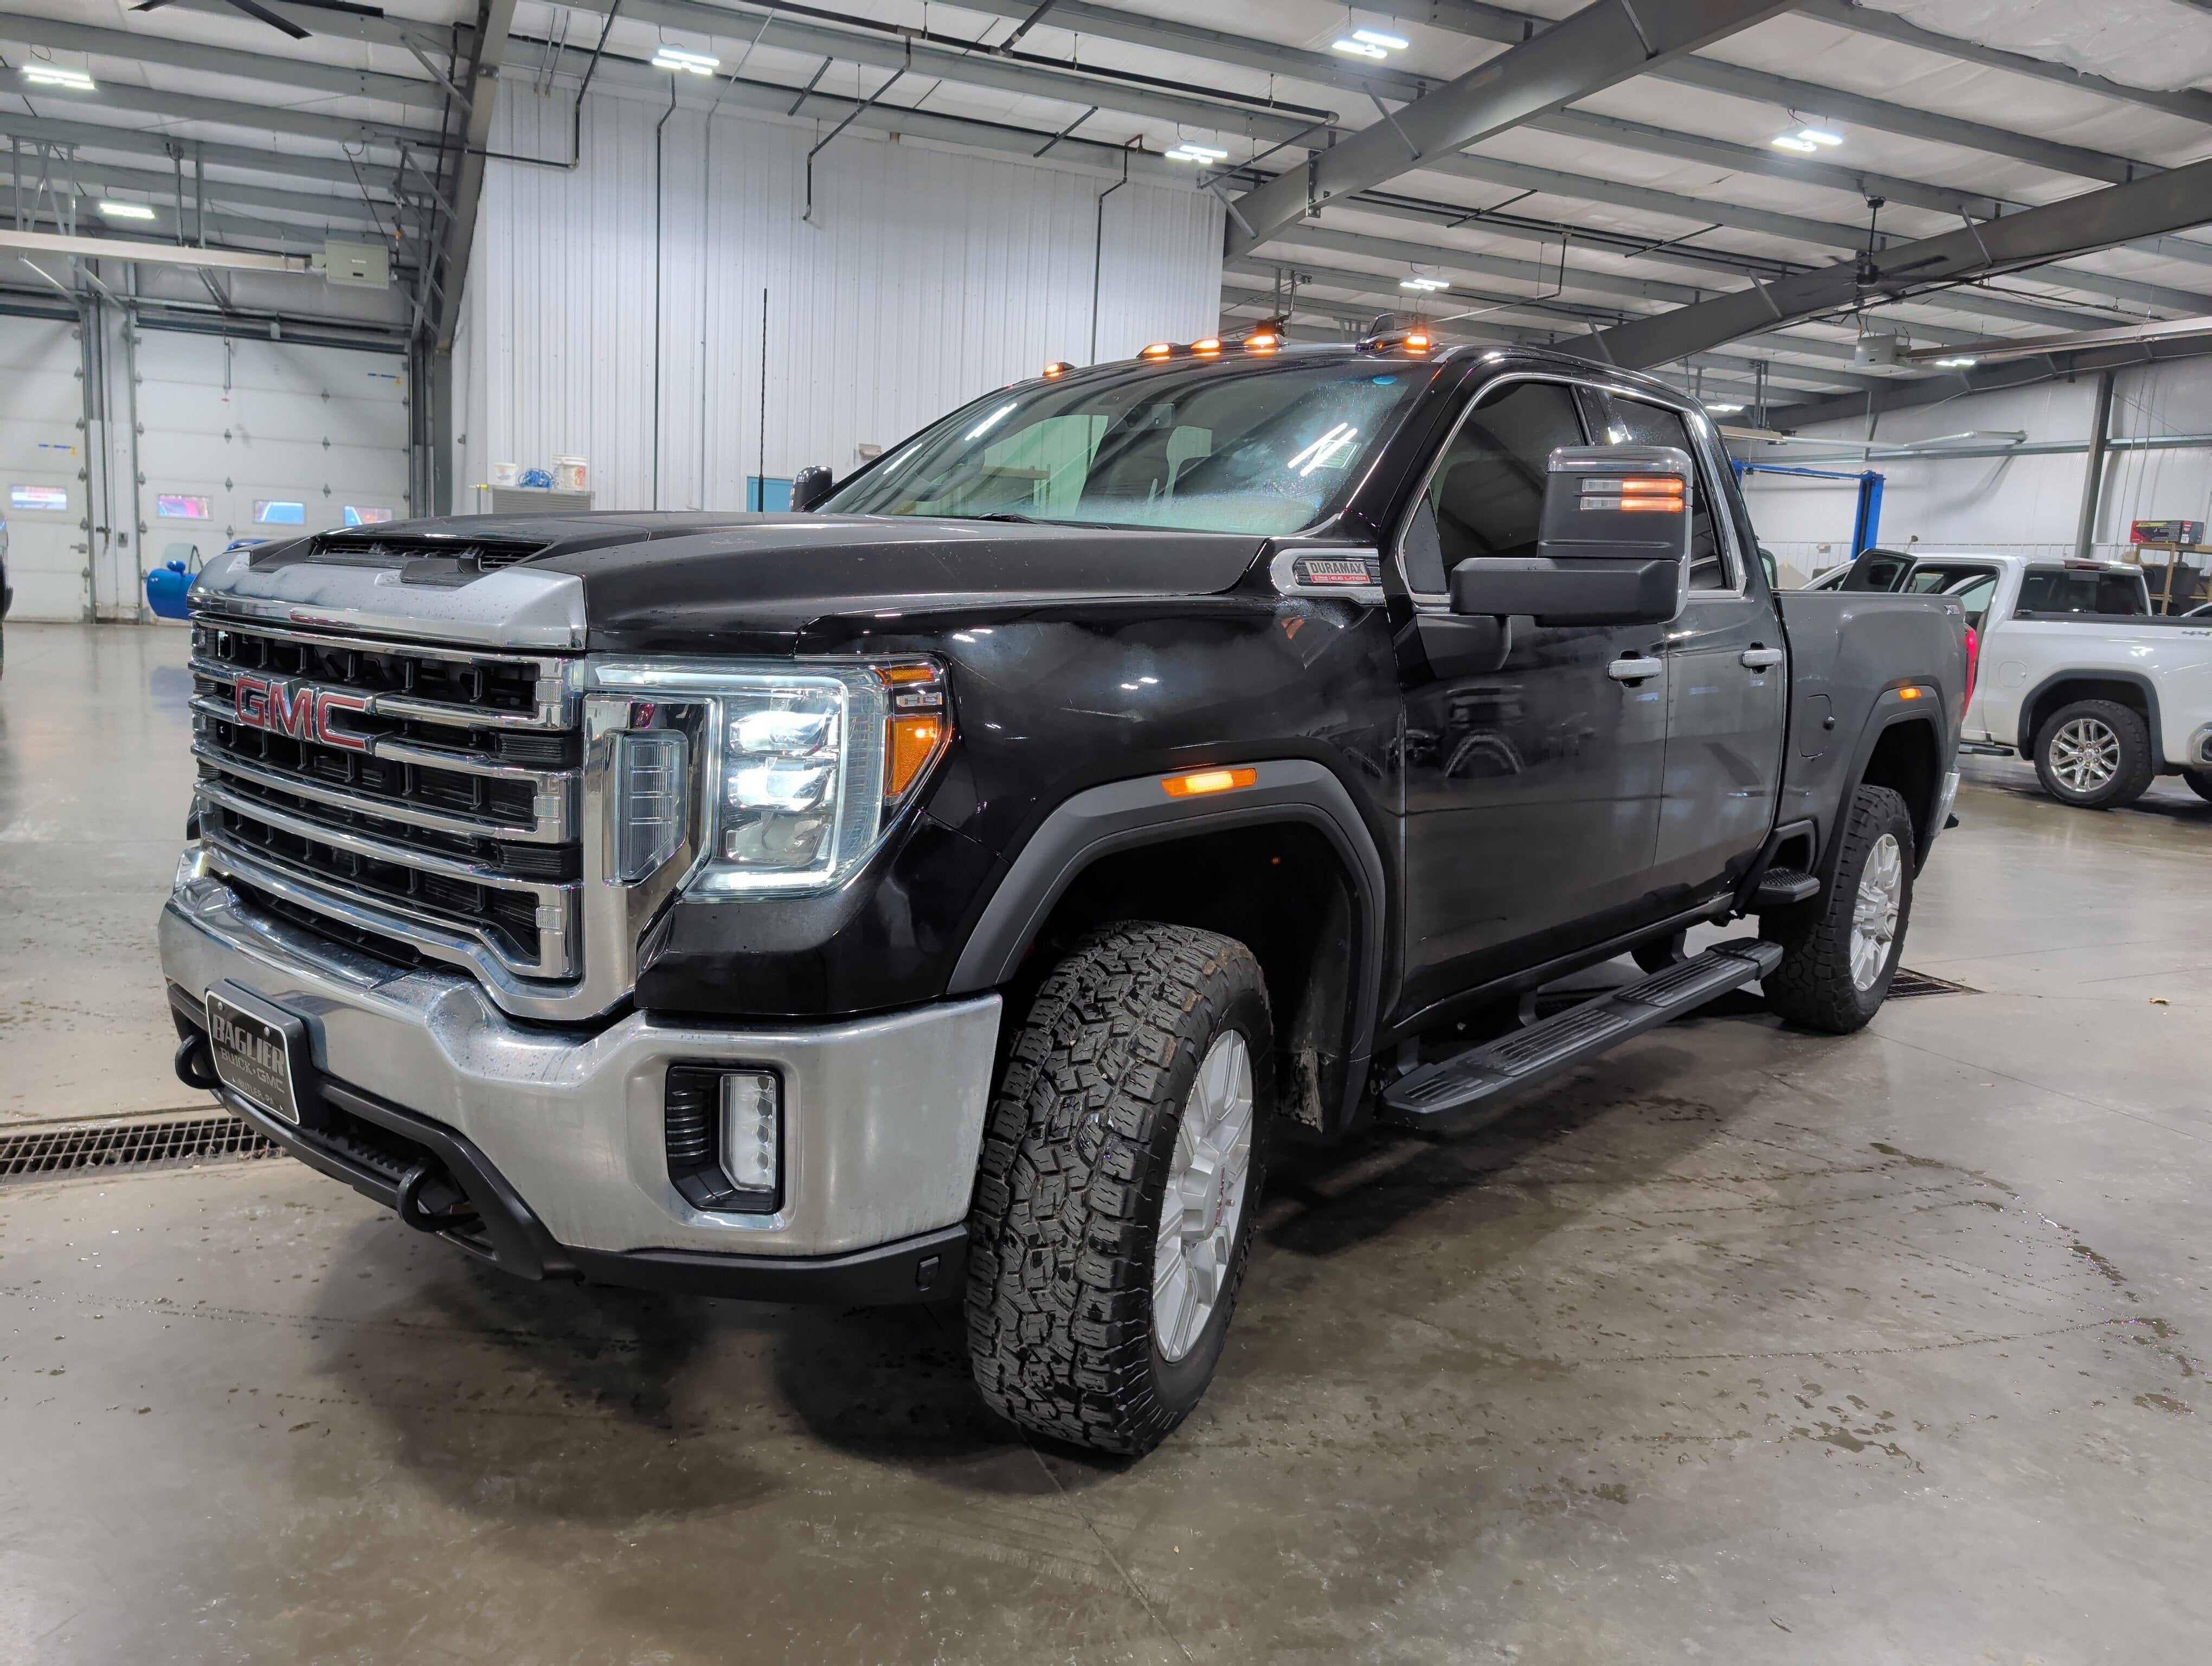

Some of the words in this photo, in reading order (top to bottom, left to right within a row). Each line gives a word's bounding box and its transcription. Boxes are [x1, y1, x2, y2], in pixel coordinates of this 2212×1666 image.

[1310, 562, 1364, 574] DURAMAX
[236, 677, 370, 752] GMC
[213, 1014, 285, 1077] BAGLIER
